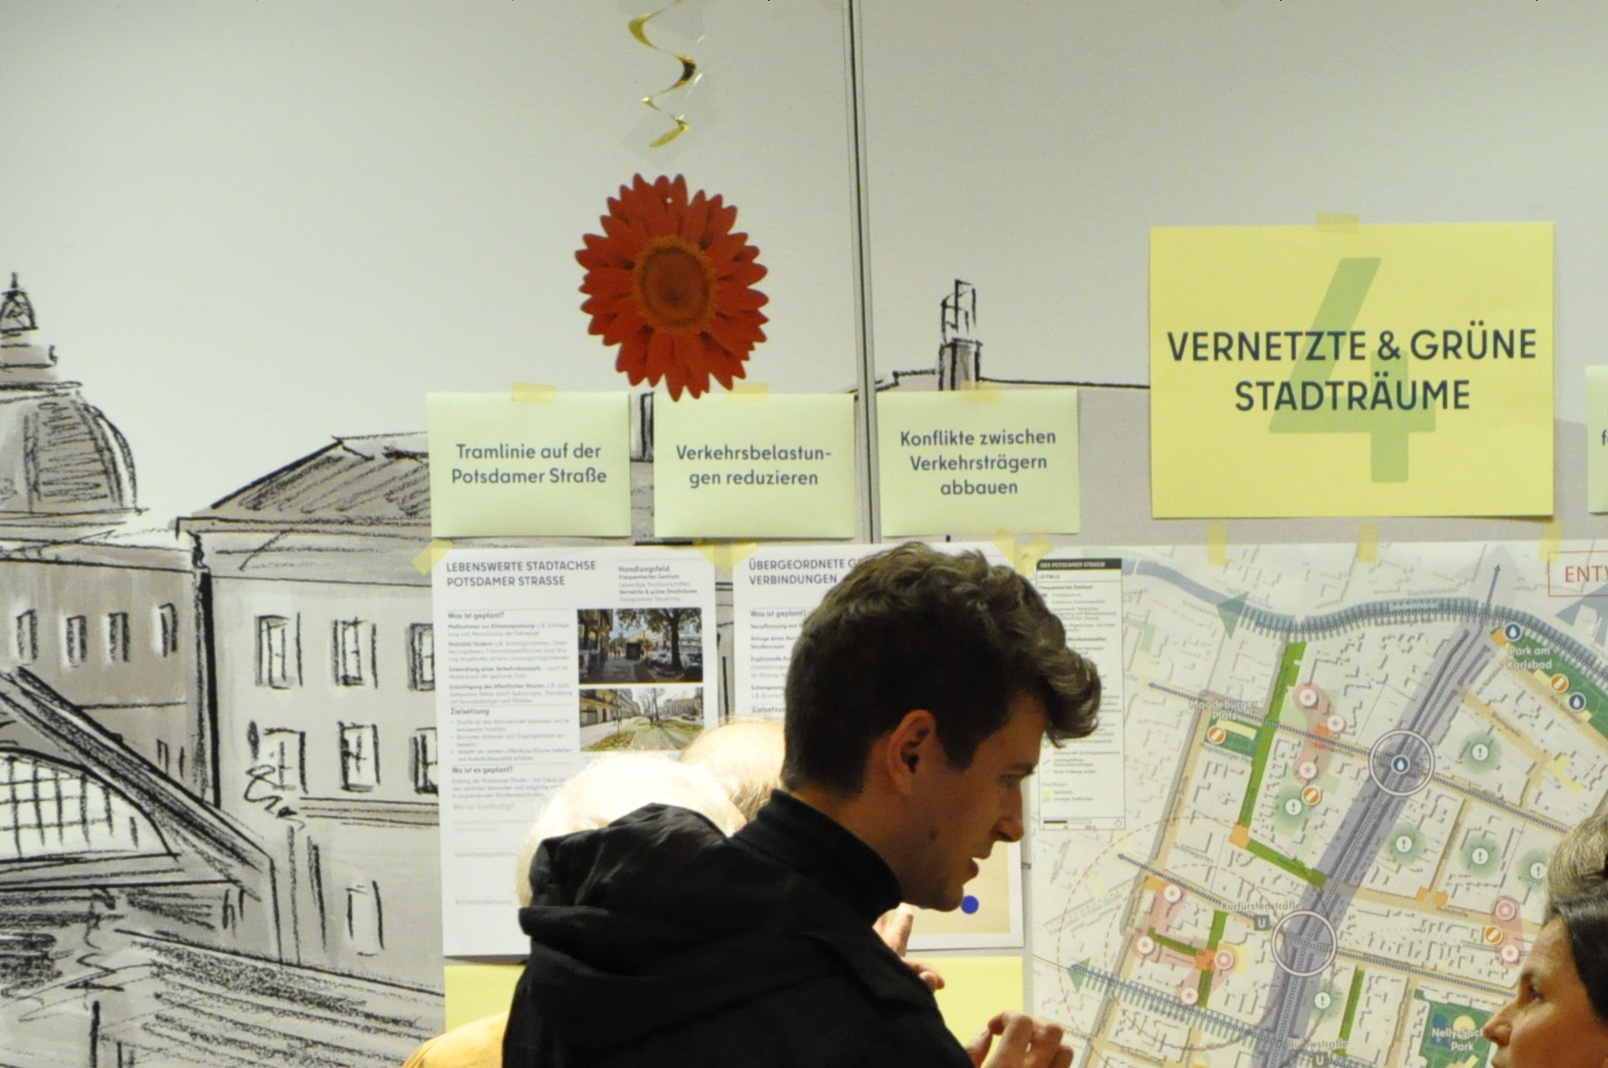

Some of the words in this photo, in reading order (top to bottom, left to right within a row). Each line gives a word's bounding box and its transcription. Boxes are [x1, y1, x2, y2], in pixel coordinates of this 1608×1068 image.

[1167, 331, 1366, 362] VERNETZTE
[1378, 331, 1400, 360] &
[1410, 320, 1537, 360] GRÜNE
[1235, 371, 1470, 411] STADTRÄUME
[900, 429, 975, 447] Konflikte
[980, 429, 1056, 446] zwischen
[456, 443, 536, 460] Tramlinie
[541, 443, 568, 459] auf
[573, 443, 601, 459] der
[676, 443, 831, 462] Verkehrsbelastun-
[910, 454, 1047, 472] Verkehrsträgern
[451, 468, 544, 485] Potsdamer
[550, 467, 607, 484] Straße
[689, 471, 720, 488] gen
[726, 469, 818, 486] reduzieren
[940, 478, 1018, 495] abbauen
[446, 561, 523, 573] LEBENSWERTE
[526, 560, 596, 571] STADTACHSE
[619, 565, 670, 573] Handlungsfeld
[749, 558, 845, 570] ÜBERGEORDNETE
[447, 576, 516, 587] POTSDAMER
[518, 576, 566, 586] STRASSE
[750, 574, 837, 585] VERBINDUNGEN
[473, 611, 504, 620] geplant?
[776, 610, 806, 618] geplant?
[1508, 647, 1531, 656] Park
[1507, 660, 1553, 670] Karlsbad
[1189, 699, 1257, 710] Magdeburger
[450, 708, 489, 716] Zielsetzung
[1213, 711, 1237, 720] Platz
[483, 766, 513, 774] geplant?
[1222, 900, 1303, 910] Kurfürstenstraße
[1451, 1042, 1474, 1051] Park
